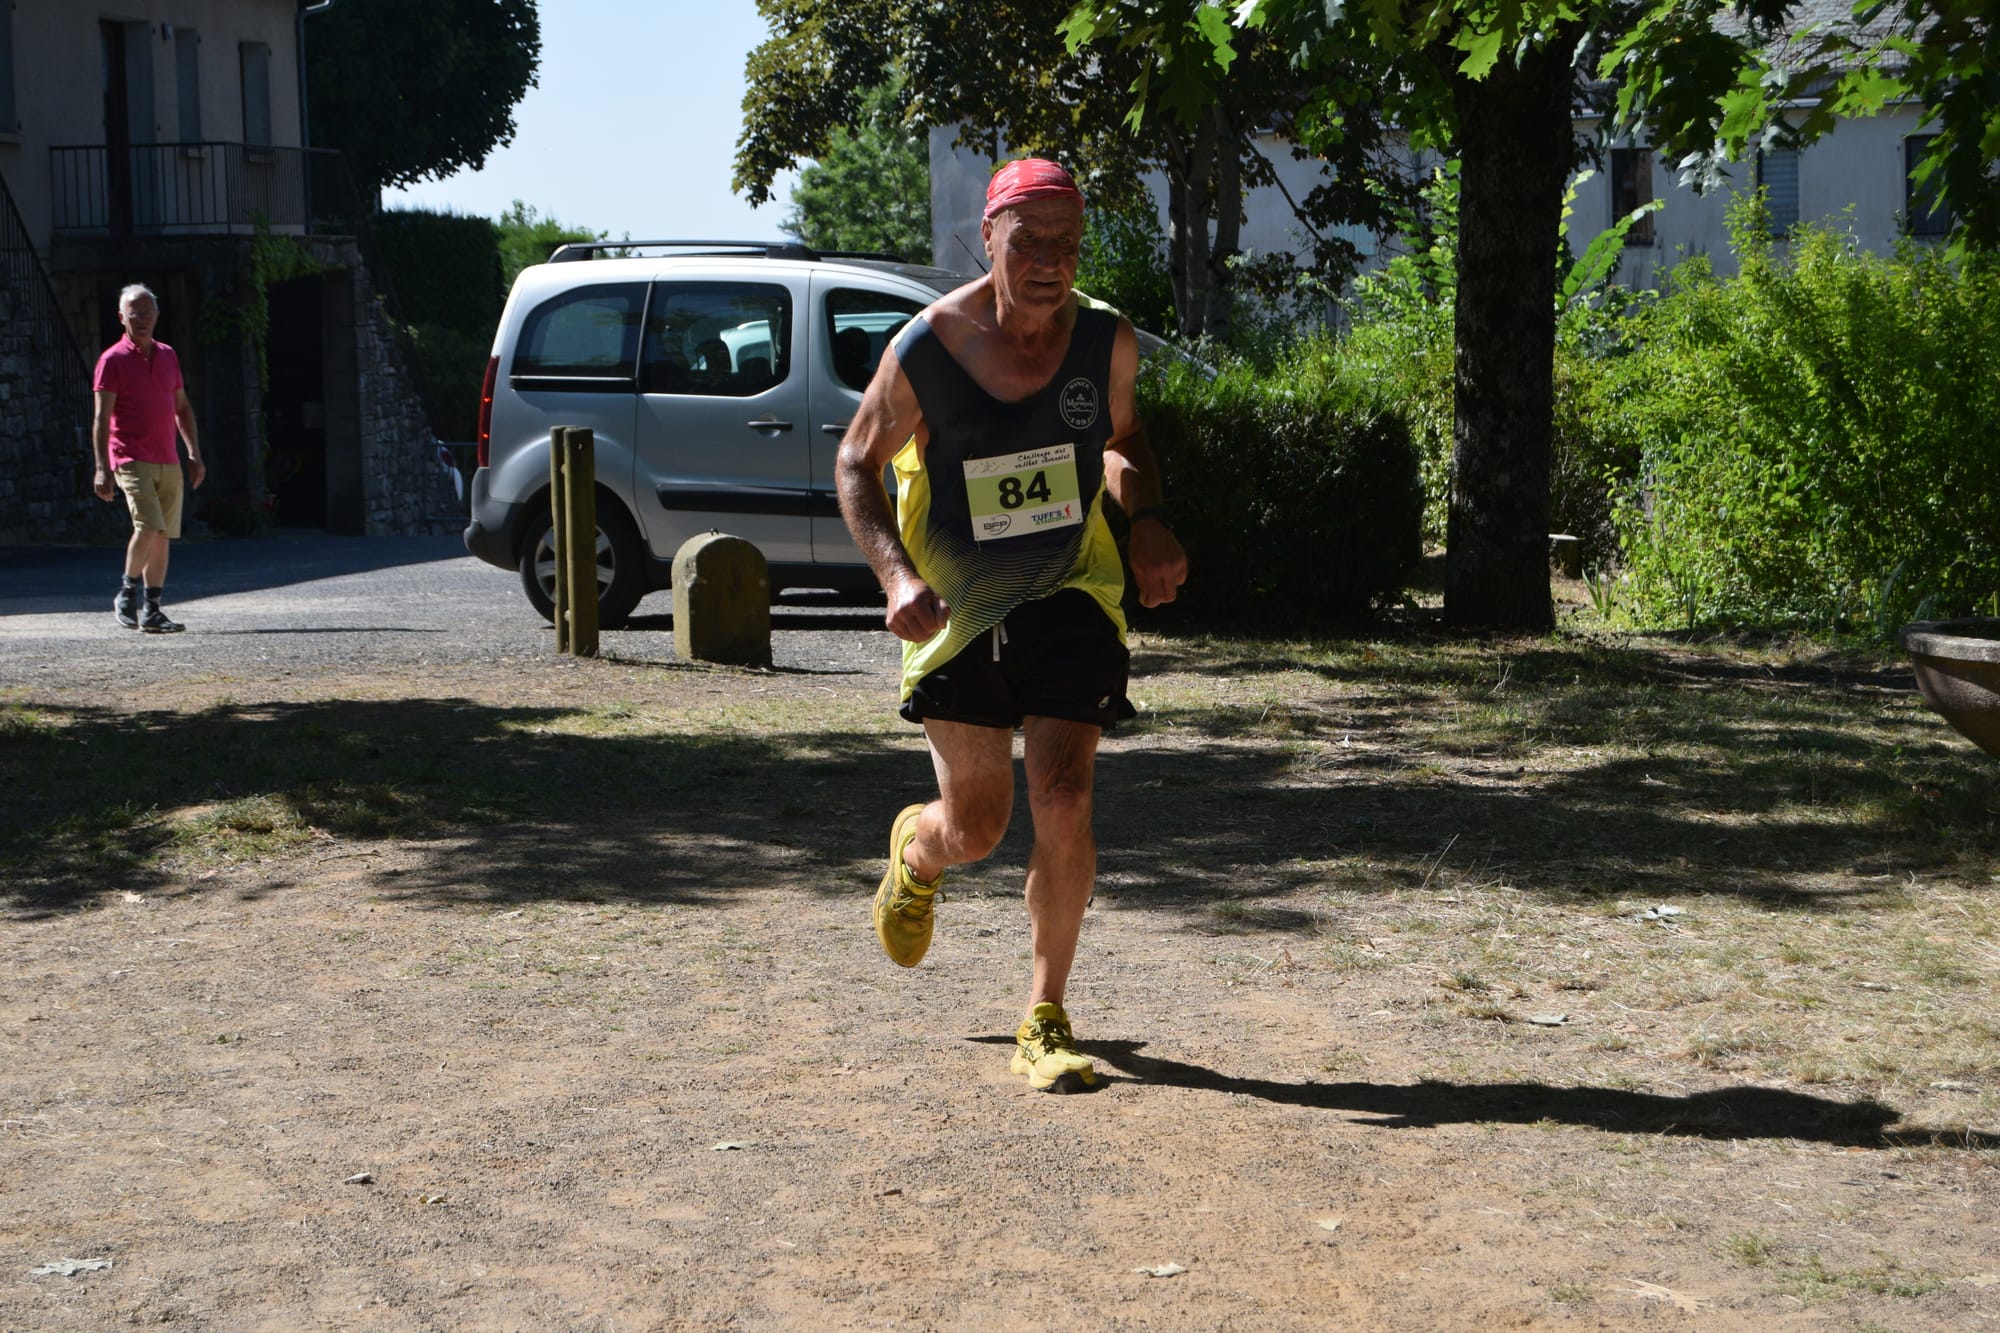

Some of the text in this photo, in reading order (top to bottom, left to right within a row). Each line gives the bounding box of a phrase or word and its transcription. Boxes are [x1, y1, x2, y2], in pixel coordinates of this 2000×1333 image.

[1017, 447, 1066, 461] Challenge des
[998, 471, 1051, 509] 84
[1031, 509, 1062, 521] TUFF'S
